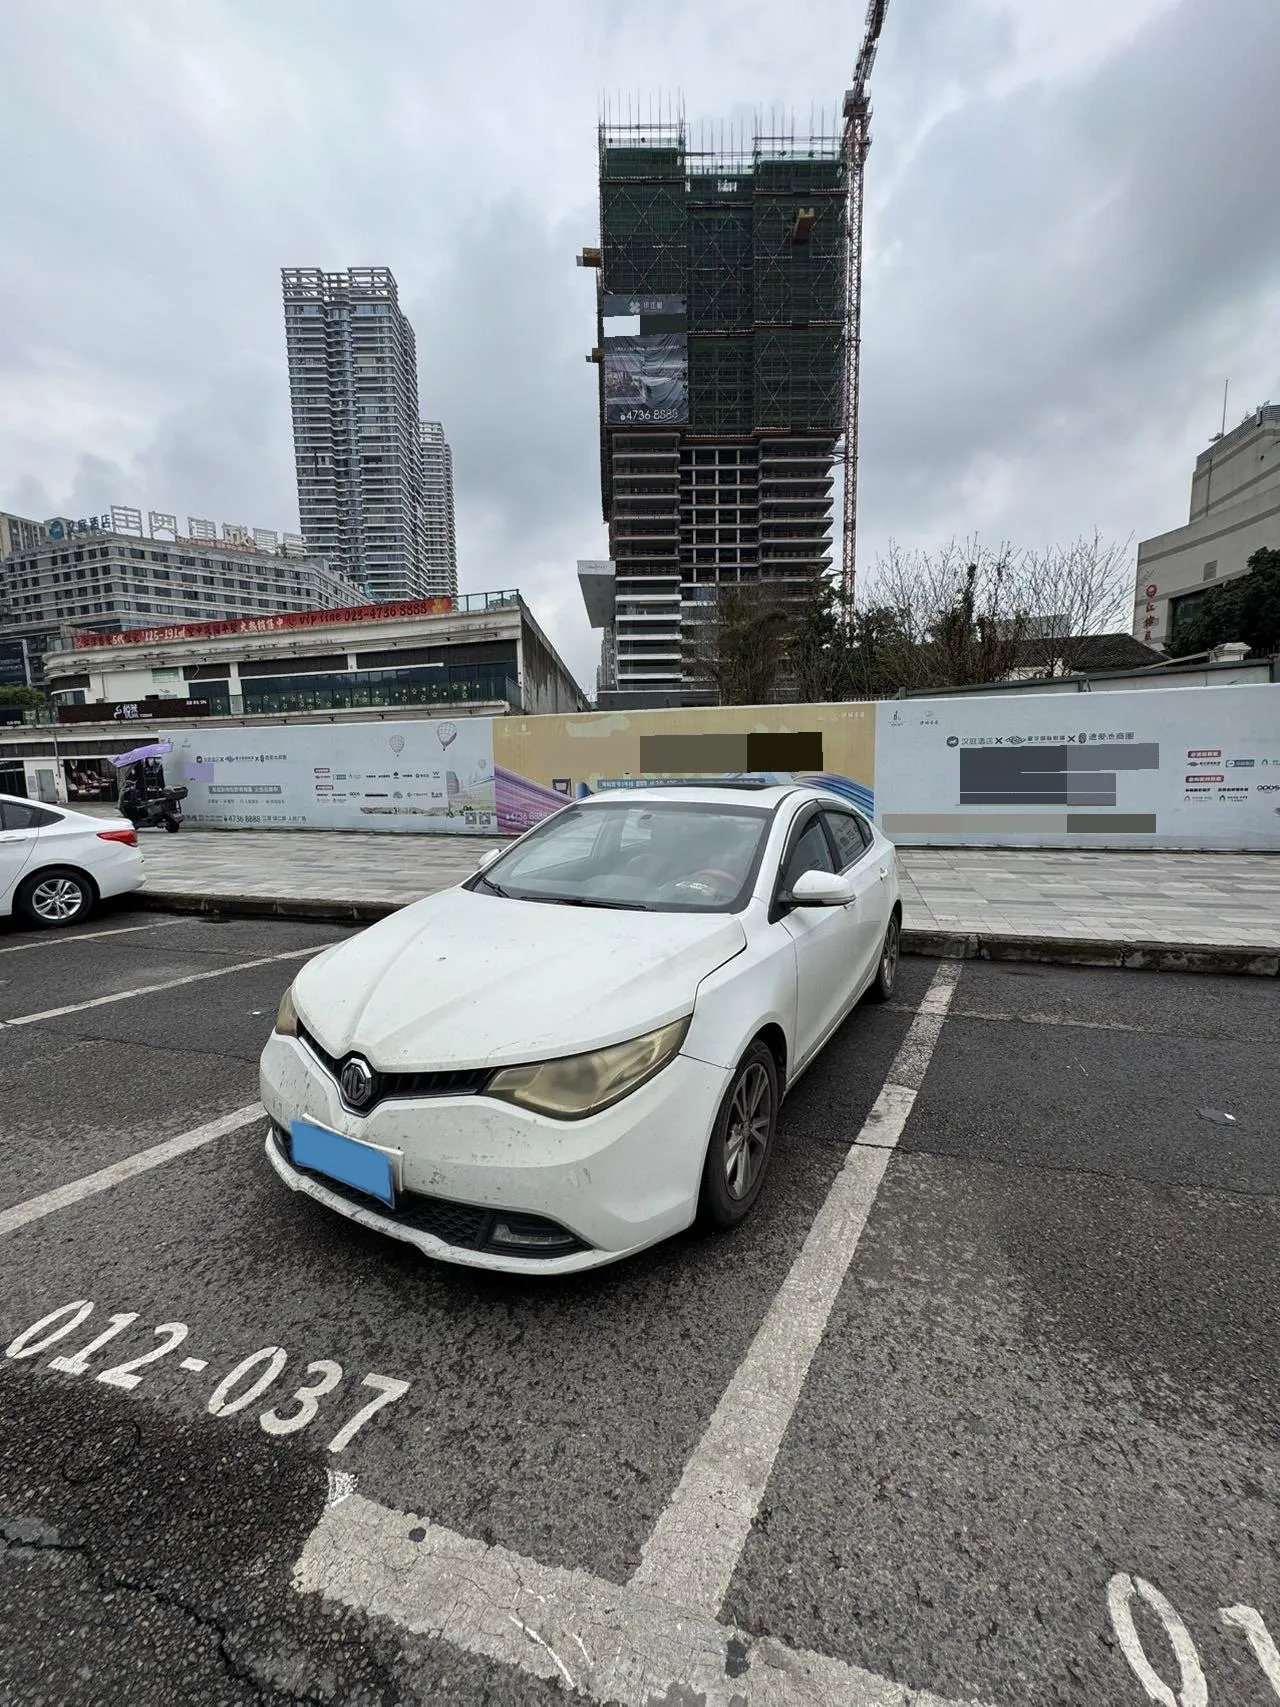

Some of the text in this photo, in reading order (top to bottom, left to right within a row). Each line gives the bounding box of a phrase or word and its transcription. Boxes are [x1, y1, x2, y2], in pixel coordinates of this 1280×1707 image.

[626, 408, 679, 420] 4736 8888
[345, 607, 396, 622] 023-4736
[399, 603, 427, 616] 8888
[5, 1300, 411, 1453] 012-037
